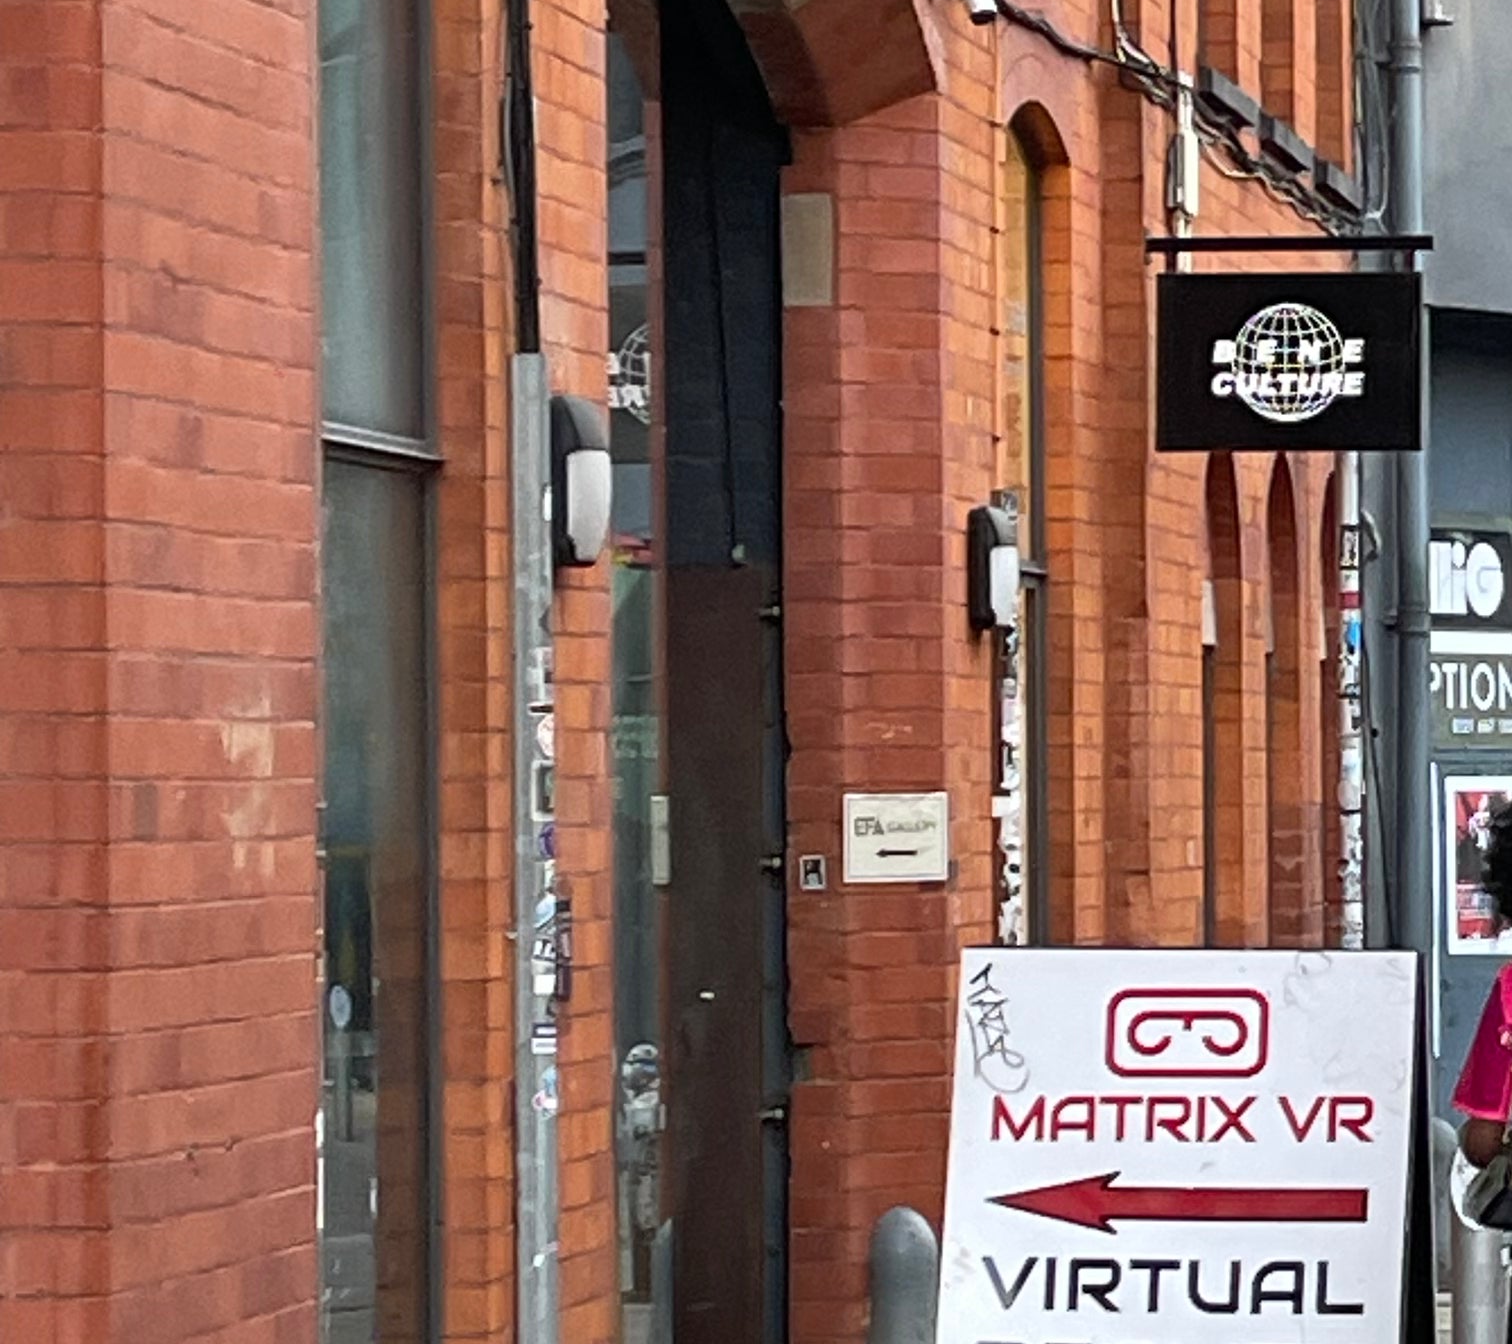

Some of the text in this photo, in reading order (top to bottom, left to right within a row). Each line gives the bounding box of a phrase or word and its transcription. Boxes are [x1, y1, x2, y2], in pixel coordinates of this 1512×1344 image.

[1211, 372, 1366, 397] CULTURE
[990, 1094, 1375, 1143] MATRIX VR
[982, 1256, 1365, 1315] VIRTUAL
